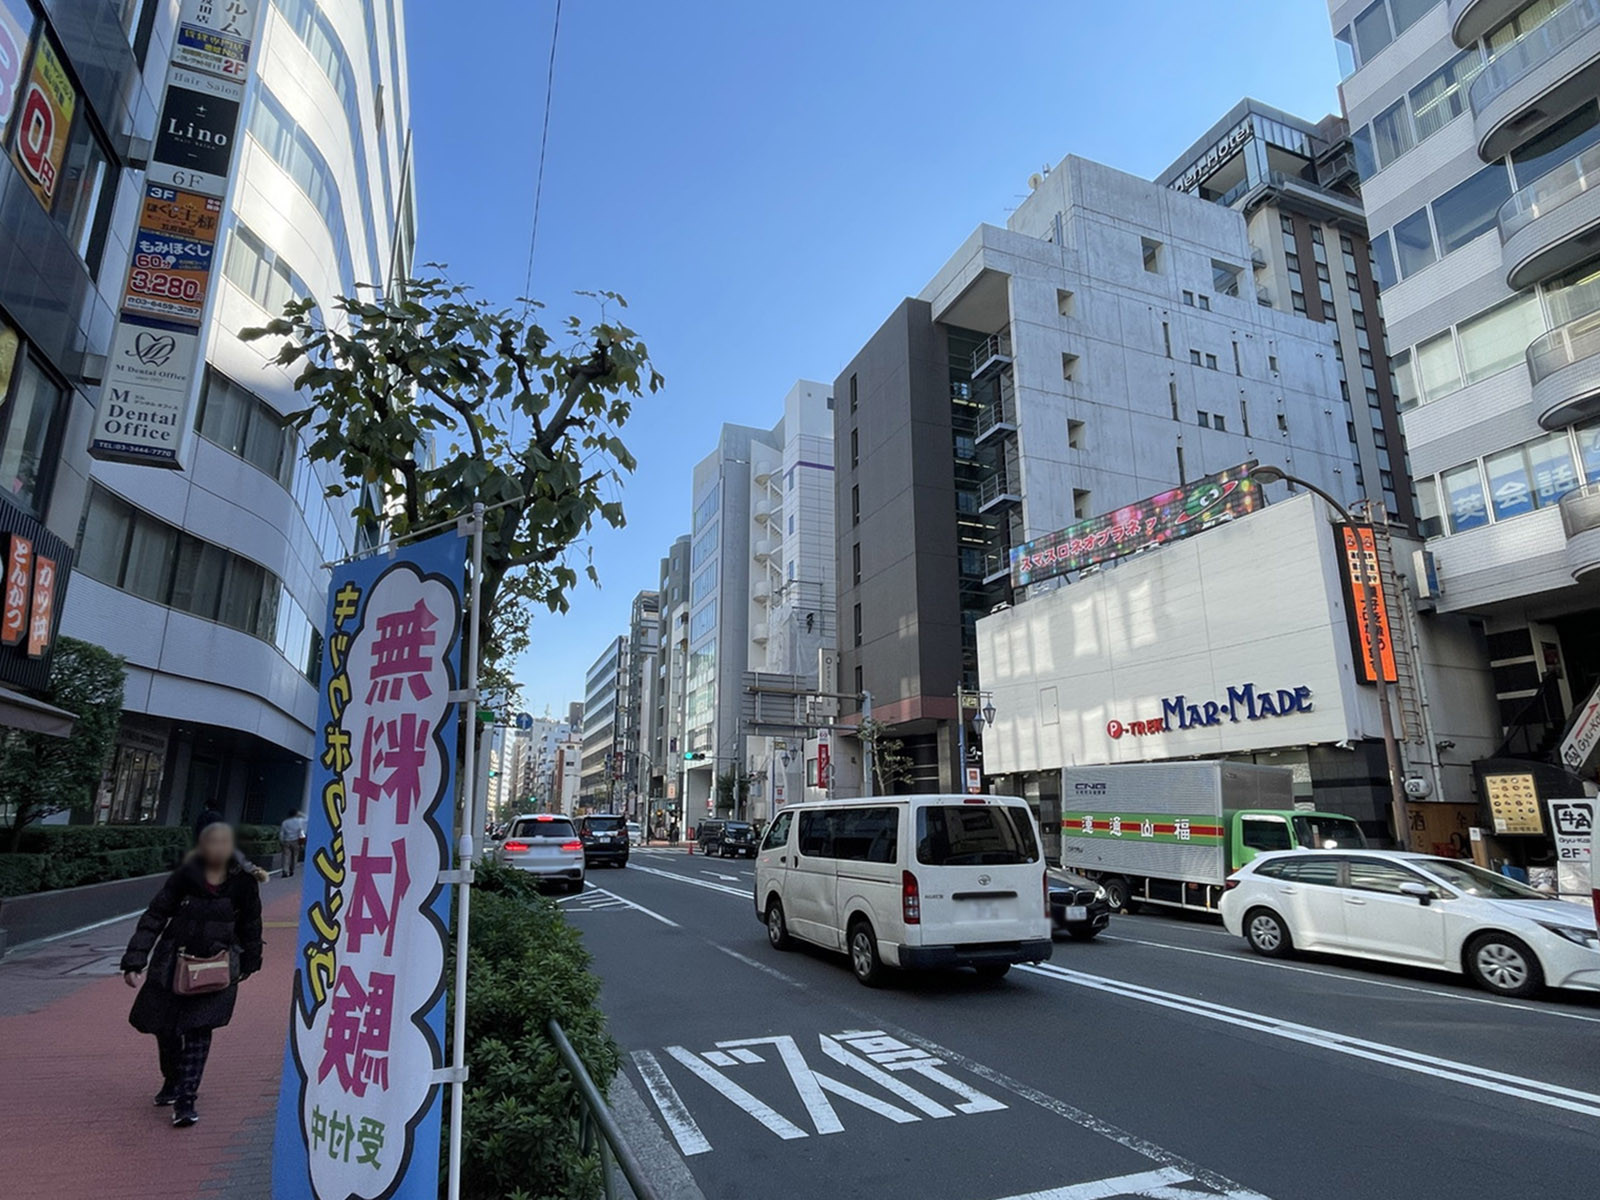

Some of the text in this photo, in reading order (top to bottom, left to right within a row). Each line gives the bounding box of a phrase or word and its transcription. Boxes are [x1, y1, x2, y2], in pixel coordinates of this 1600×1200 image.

[221, 0, 247, 36] ルーム
[223, 59, 245, 75] 2F
[174, 72, 239, 96] Hair Salon
[168, 117, 228, 146] Lino
[1207, 118, 1252, 169] Hotel
[172, 171, 204, 188] 6F
[150, 186, 175, 200] 3F
[139, 240, 210, 257] もみほぐし
[136, 253, 172, 269] 60分
[128, 366, 156, 376] Dental
[159, 368, 186, 380] Office
[109, 388, 130, 403] M
[108, 404, 177, 426] Dental
[104, 420, 171, 441] Office
[1453, 463, 1574, 523] 英会話
[8, 538, 28, 629] とんかつ
[1075, 782, 1107, 790] CNG
[1561, 810, 1592, 829] 牛角
[1560, 848, 1581, 858] 2F
